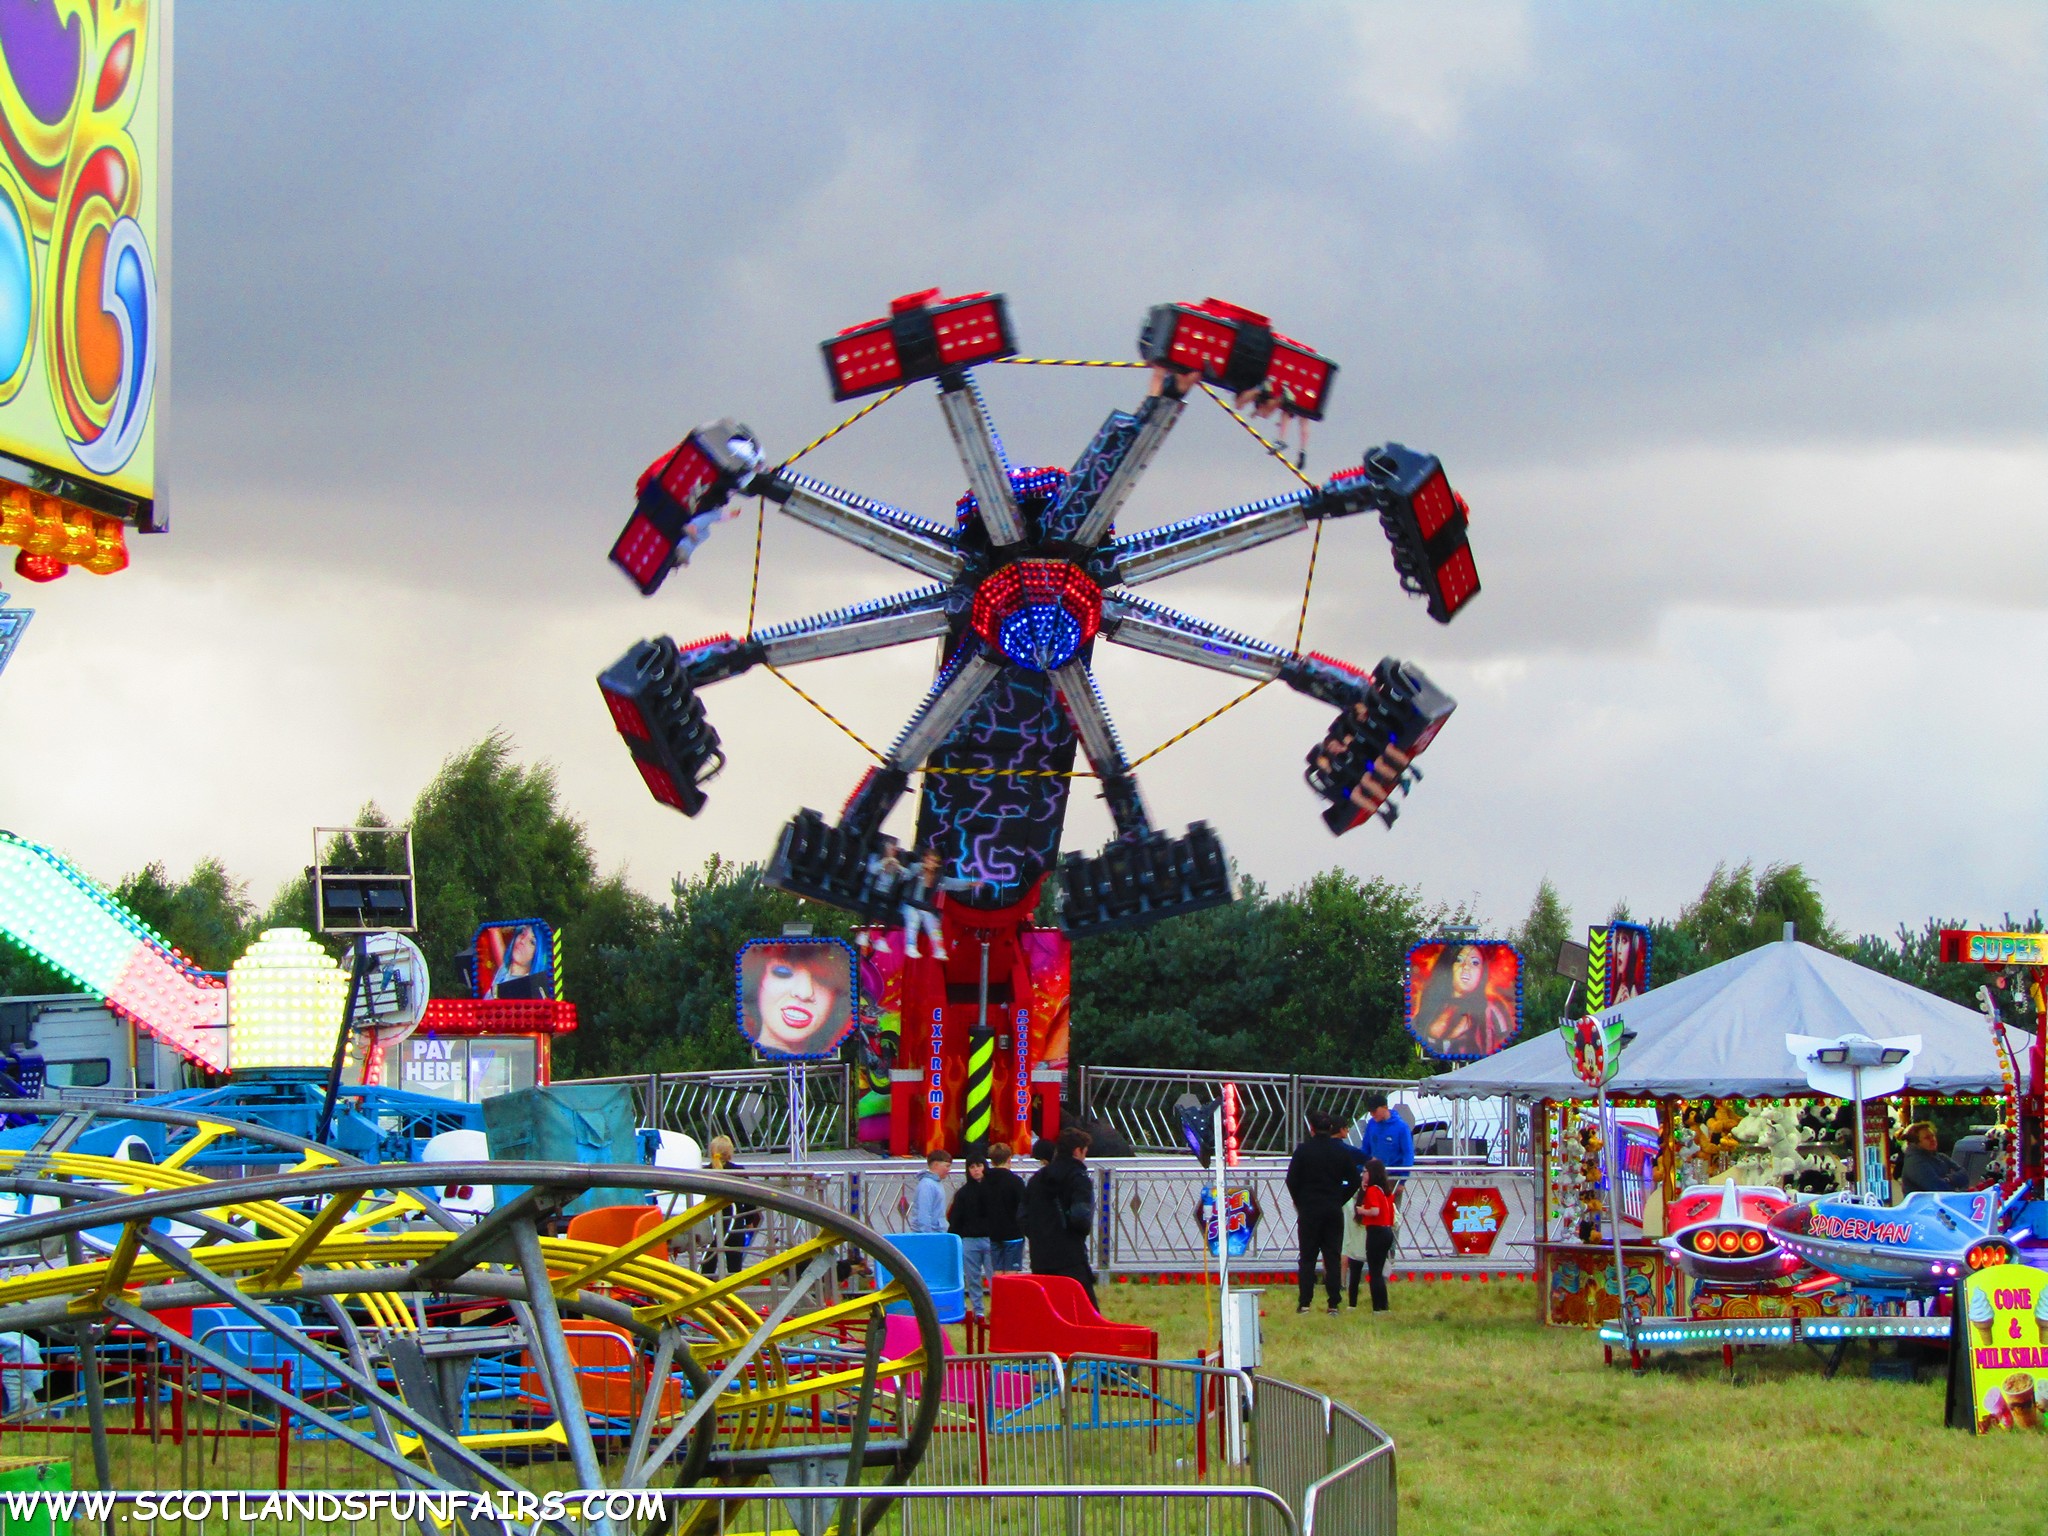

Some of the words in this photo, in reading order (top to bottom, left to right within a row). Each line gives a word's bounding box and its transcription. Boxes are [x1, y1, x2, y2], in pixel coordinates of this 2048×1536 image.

[1970, 935, 2044, 963] SUPER
[413, 1040, 456, 1060] PAY
[1016, 1009, 1029, 1087] ADRENALINE
[406, 1061, 463, 1081] HERE
[929, 1007, 944, 1120] EXTREME
[1017, 1090, 1028, 1121] RUSH
[1456, 1205, 1492, 1220] TOP
[1971, 1196, 1987, 1222] 2
[1207, 1212, 1247, 1240] SAR
[1452, 1217, 1497, 1233] STAR
[1808, 1213, 1912, 1244] SPIDERMAN
[1994, 1288, 2032, 1310] CONE
[2009, 1317, 2022, 1339] &
